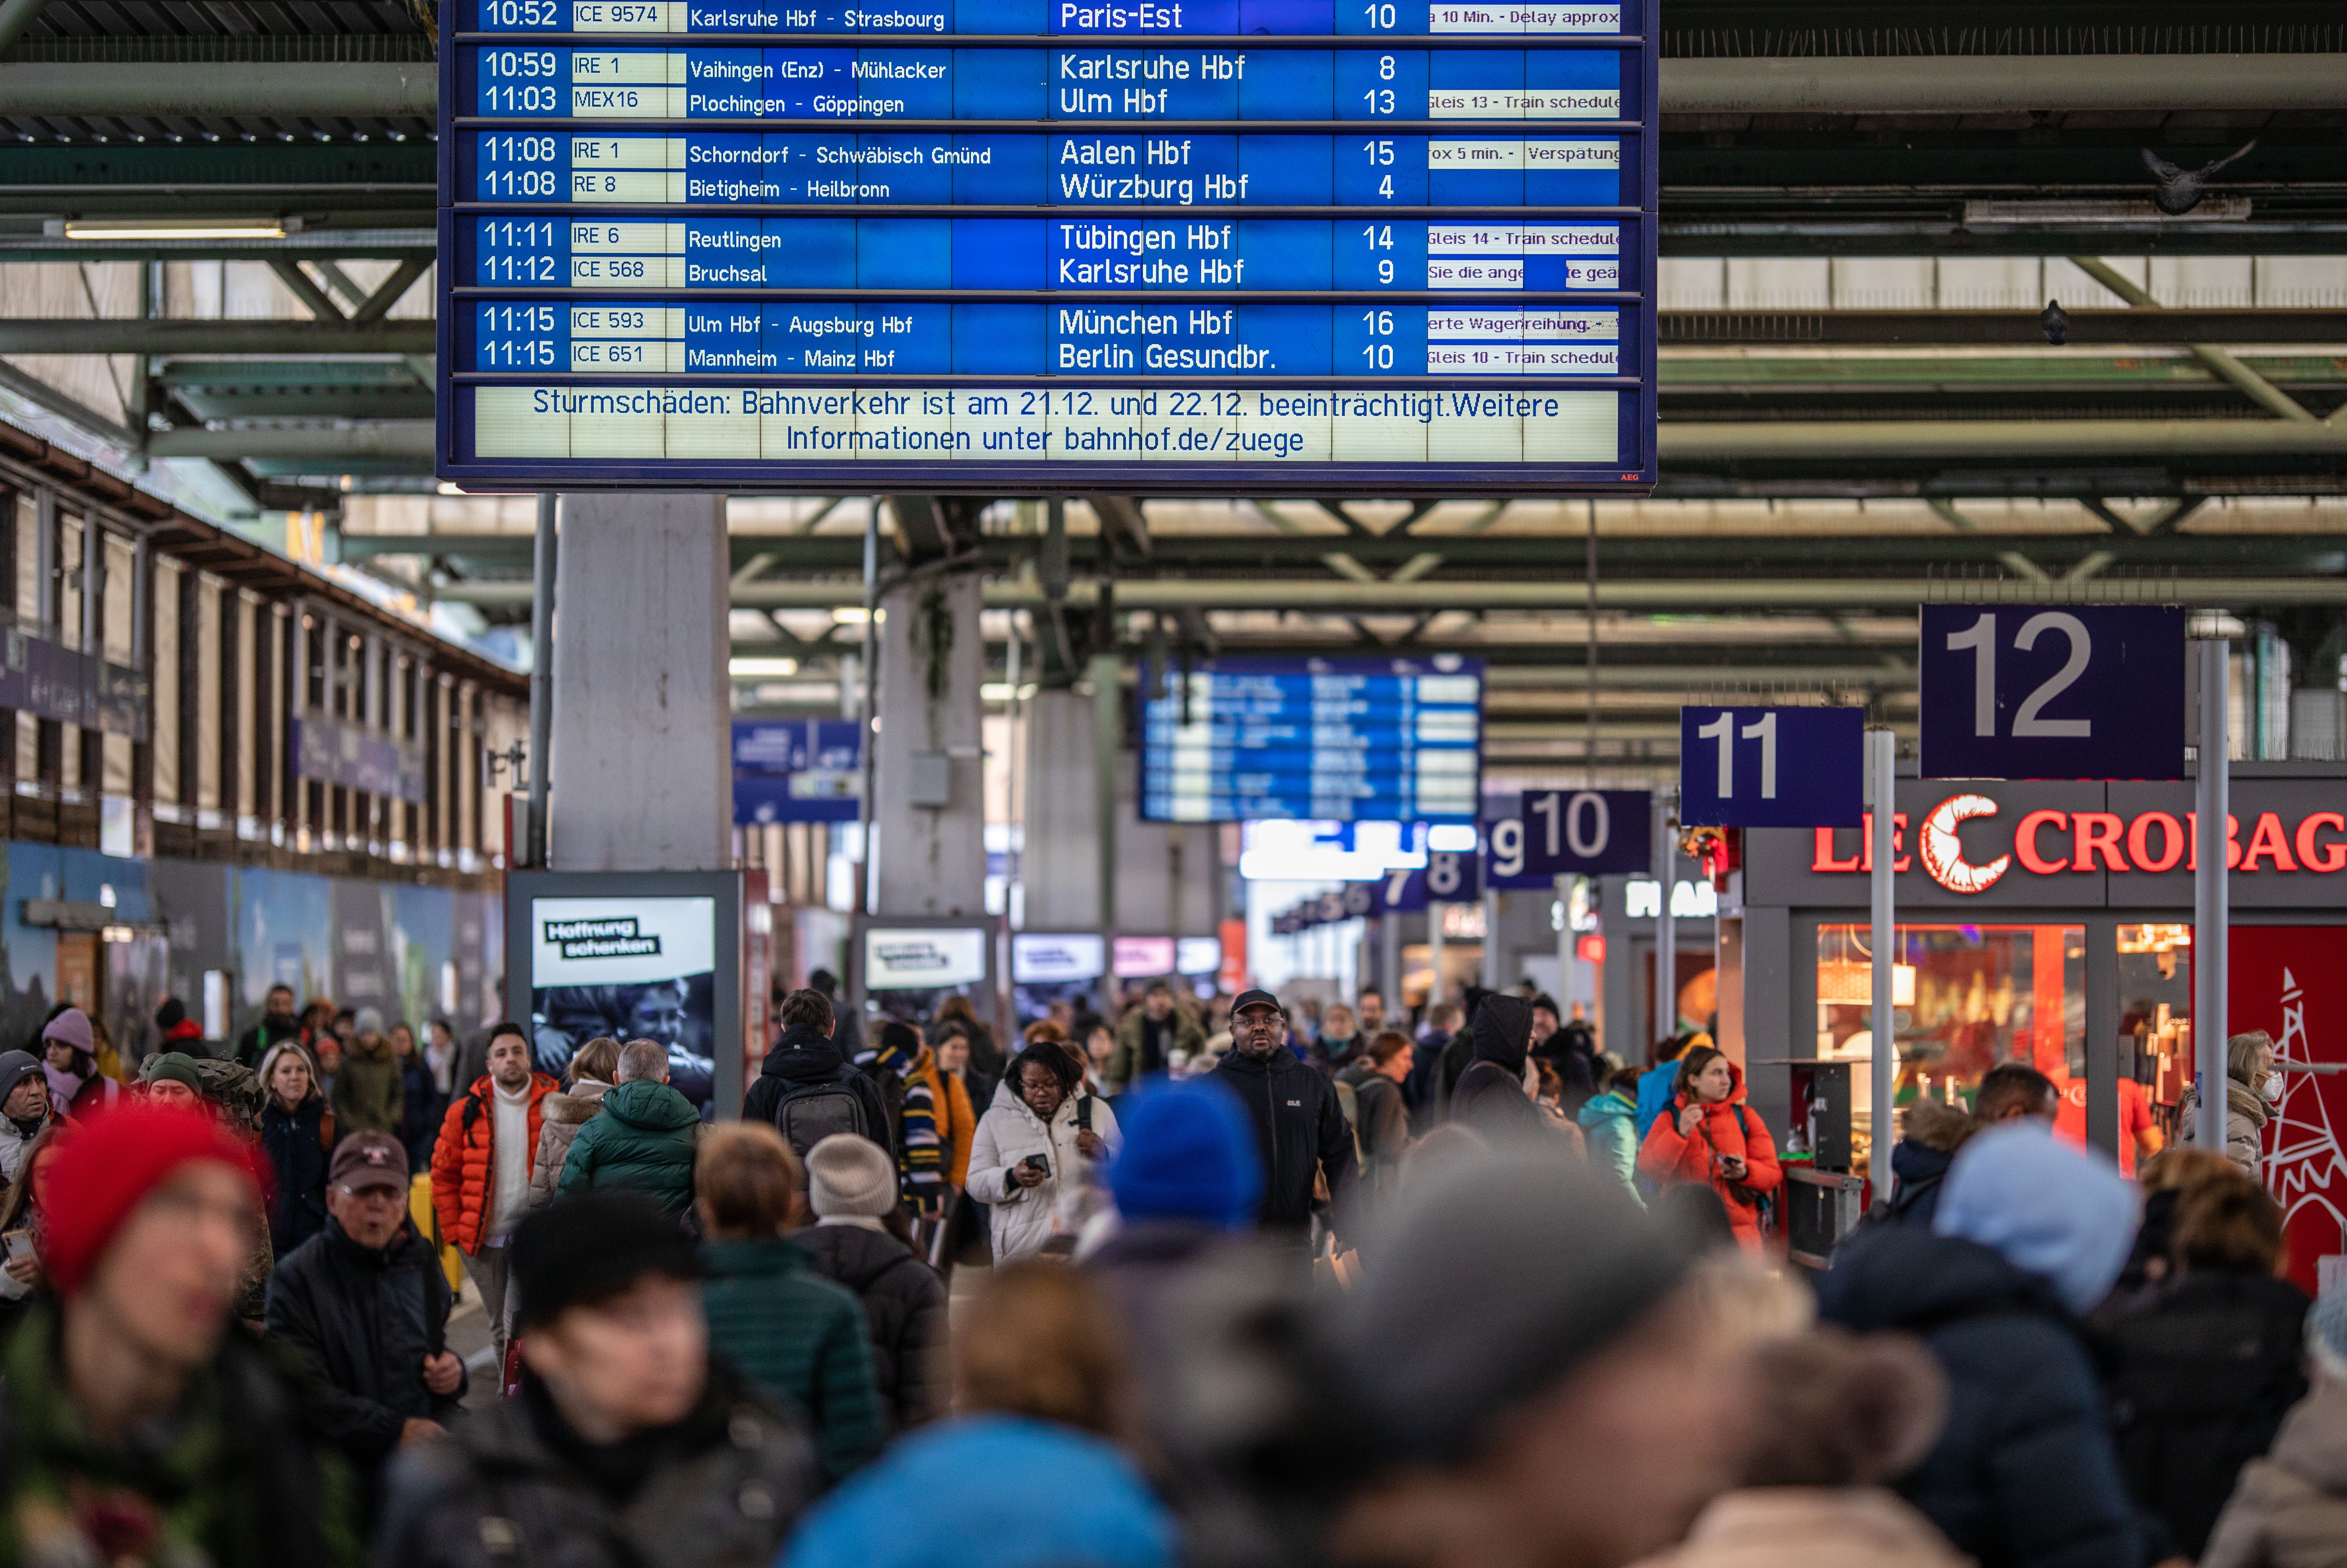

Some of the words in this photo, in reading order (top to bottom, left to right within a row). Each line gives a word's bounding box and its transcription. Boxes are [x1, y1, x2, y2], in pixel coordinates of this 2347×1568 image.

[487, 1, 557, 25] 10:52
[576, 6, 602, 22] ICE
[612, 6, 658, 22] 9574
[692, 10, 778, 26] Karlsruhe
[787, 10, 816, 26] Hbf
[845, 11, 944, 31] Strasbourg
[1062, 3, 1182, 28] Paris-Est
[1365, 4, 1395, 28] 10
[1443, 11, 1458, 23] 10
[1464, 11, 1494, 23] Min.
[1511, 11, 1557, 26] Delay
[1563, 14, 1619, 26] approx
[486, 52, 555, 76] 10:59
[575, 57, 600, 74] IRE
[611, 57, 618, 74] 1
[691, 61, 773, 81] Vaihingen
[782, 62, 823, 78] (Enz)
[852, 62, 946, 78] Mühlacker
[1061, 55, 1189, 79] Karlsruhe
[1202, 55, 1245, 79] Hbf
[1380, 56, 1395, 79] 8
[486, 86, 555, 110] 11:03
[575, 91, 638, 107] MEX16
[691, 95, 785, 116] Plochingen
[813, 95, 904, 116] Göppingen
[1061, 88, 1112, 113] Ulm
[1125, 88, 1167, 113] Hbf
[1364, 89, 1395, 113] 13
[1471, 97, 1487, 108] 13
[1504, 97, 1544, 108] Train
[485, 137, 555, 161] 11:08
[575, 142, 600, 158] IRE
[611, 142, 618, 158] 1
[690, 146, 788, 163] Schorndorf
[817, 147, 923, 163] Schwäbisch
[932, 147, 990, 164] Gmünd
[1061, 140, 1135, 164] Aalen
[1148, 140, 1191, 164] Hbf
[1364, 141, 1394, 165] 15
[1429, 148, 1452, 159] ox
[1457, 148, 1466, 159] 5
[1472, 148, 1502, 159] min.
[485, 171, 555, 195] 11:08
[575, 176, 596, 192] RE
[605, 176, 616, 192] 8
[690, 180, 779, 201] Bietigheim
[808, 181, 889, 197] Heilbronn
[1061, 174, 1192, 205] Würzburg
[1205, 174, 1248, 198] Hbf
[1379, 175, 1394, 199] 4
[485, 222, 552, 246] 11:11
[574, 227, 599, 243] IRE
[608, 228, 619, 243] 6
[690, 231, 781, 252] Reutlingen
[1061, 225, 1175, 256] Tübingen
[1188, 225, 1231, 249] Hbf
[1363, 226, 1394, 250] 14
[1429, 233, 1466, 244] Gleis
[1472, 233, 1489, 244] 14
[1505, 233, 1545, 244] Train
[485, 256, 555, 280] 11:12
[574, 261, 600, 277] ICE
[609, 261, 644, 277] 568
[690, 265, 767, 281] Bruchsal
[1060, 259, 1188, 283] Karlsruhe
[1201, 259, 1244, 283] Hbf
[1379, 259, 1393, 284] 9
[1429, 266, 1452, 278] Sie
[1459, 266, 1483, 278] die
[1587, 267, 1619, 282] geä
[484, 307, 554, 331] 11:15
[573, 312, 600, 328] ICE
[609, 312, 643, 328] 593
[689, 316, 722, 332] Ulm
[731, 316, 760, 332] Hbf
[789, 316, 873, 337] Augsburg
[882, 316, 912, 333] Hbf
[1060, 310, 1177, 334] München
[1190, 310, 1232, 334] Hbf
[1363, 311, 1393, 335] 16
[1428, 318, 1463, 329] erte
[1470, 318, 1590, 333] Wagenreihung.
[484, 341, 554, 365] 11:15
[573, 346, 600, 362] ICE
[609, 346, 642, 362] 651
[689, 350, 776, 366] Mannheim
[805, 350, 855, 366] Mainz
[865, 350, 895, 366] Hbf
[1060, 343, 1133, 368] Berlin
[1146, 344, 1275, 368] Gesundbr.
[1362, 345, 1393, 369] 10
[1428, 352, 1465, 363] Gleis
[1472, 352, 1488, 363] 10
[1505, 352, 1545, 363] Train
[1551, 352, 1619, 363] schedul
[534, 389, 730, 414] Sturmschäden:
[743, 390, 910, 415] Bahnverkehr
[924, 391, 955, 416] ist
[968, 397, 1008, 415] am
[1021, 392, 1098, 415] 21.12.
[1111, 392, 1157, 415] und
[1170, 392, 1247, 416] 22.12.
[1260, 393, 1558, 423] beeinträchtigt.Weitere
[788, 426, 970, 450] Informationen
[983, 426, 1052, 451] unter
[1065, 427, 1303, 457] bahnhof.de/zuege
[1946, 611, 2092, 738] 12
[1698, 711, 1776, 799] 11
[1530, 791, 1610, 859] 10
[1492, 818, 1524, 877] 9
[1811, 812, 1911, 872] LE
[1427, 851, 1461, 895] 8
[1385, 869, 1413, 905] 7
[548, 920, 635, 940] Hoffnung
[564, 938, 656, 957] schenken
